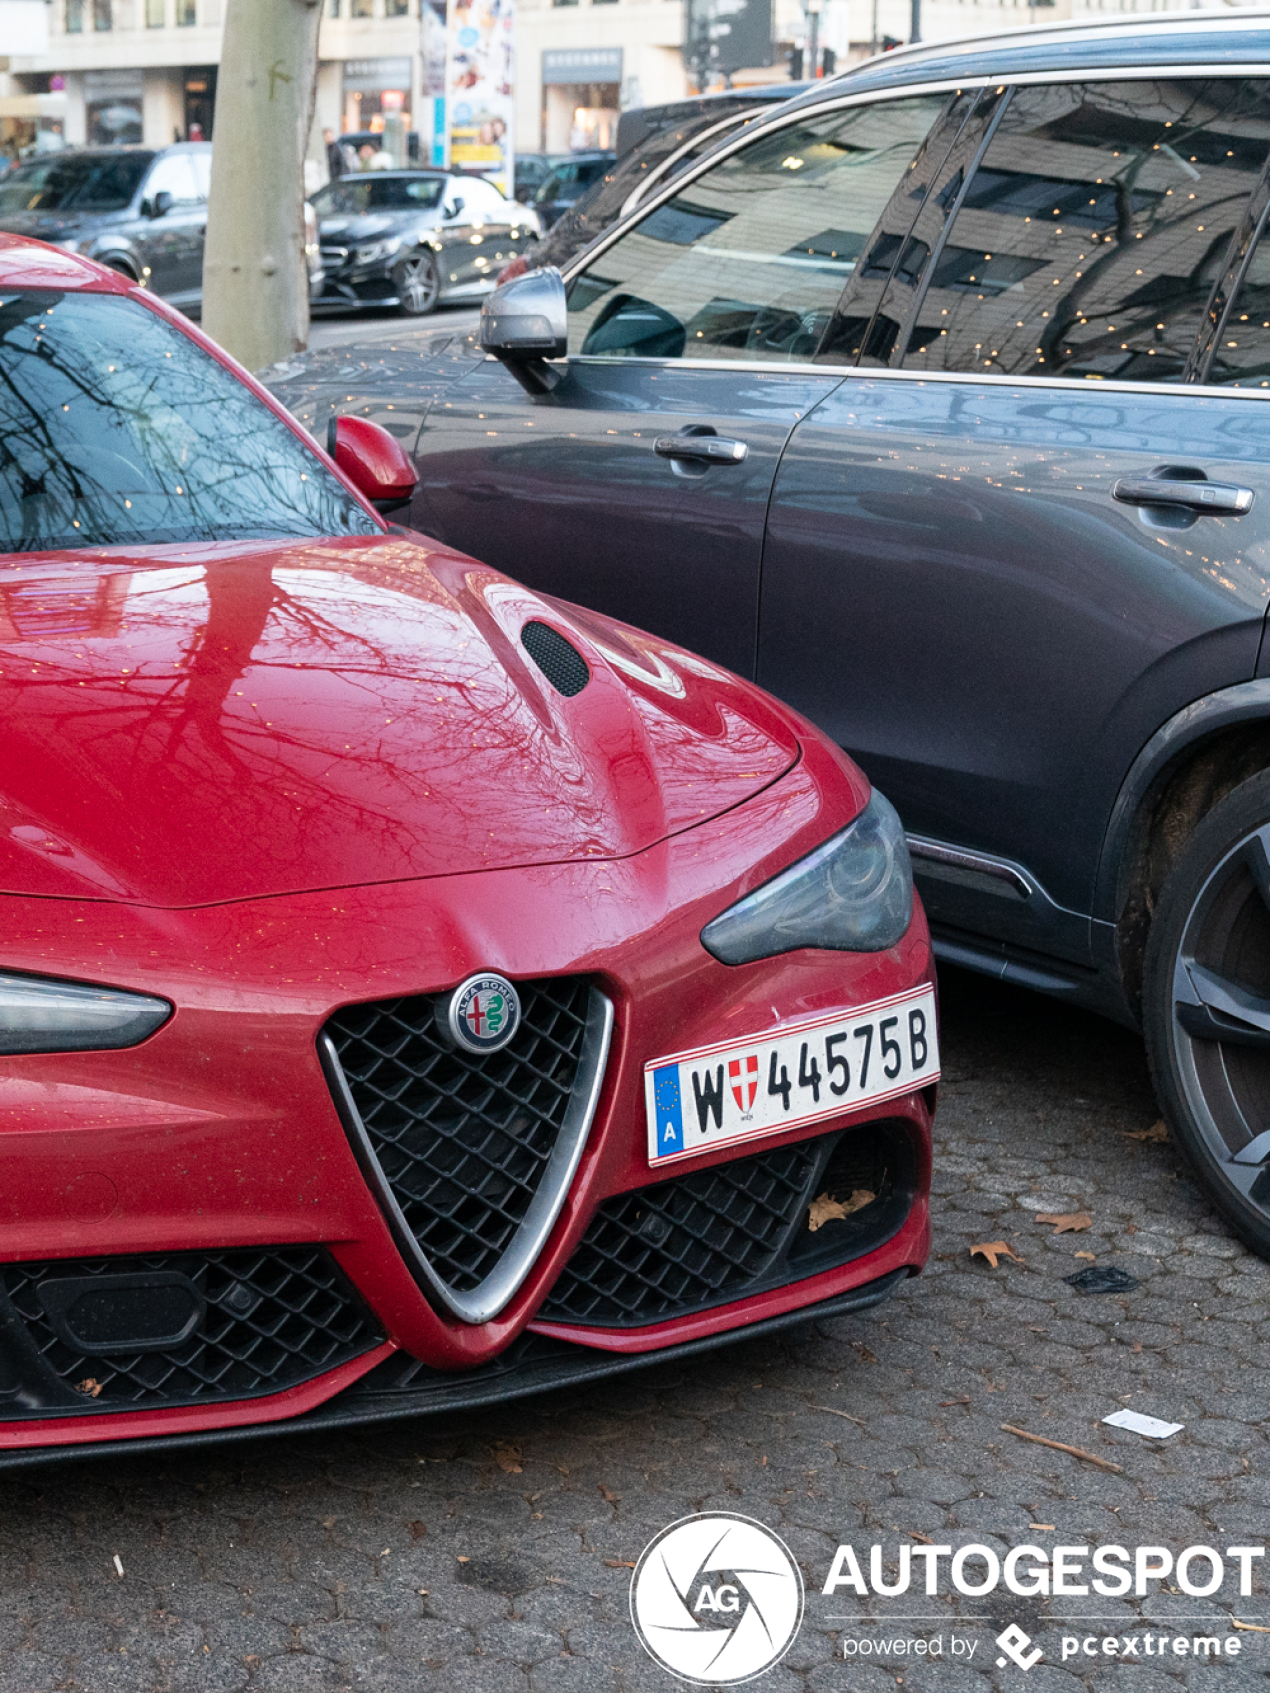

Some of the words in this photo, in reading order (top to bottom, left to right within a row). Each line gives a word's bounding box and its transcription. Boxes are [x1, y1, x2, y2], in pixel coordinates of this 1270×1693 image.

[459, 987, 479, 1016] ALFA
[482, 981, 514, 1012] ROMEO
[691, 1063, 724, 1133] W
[767, 1008, 928, 1111] 44575B
[663, 1121, 677, 1143] A
